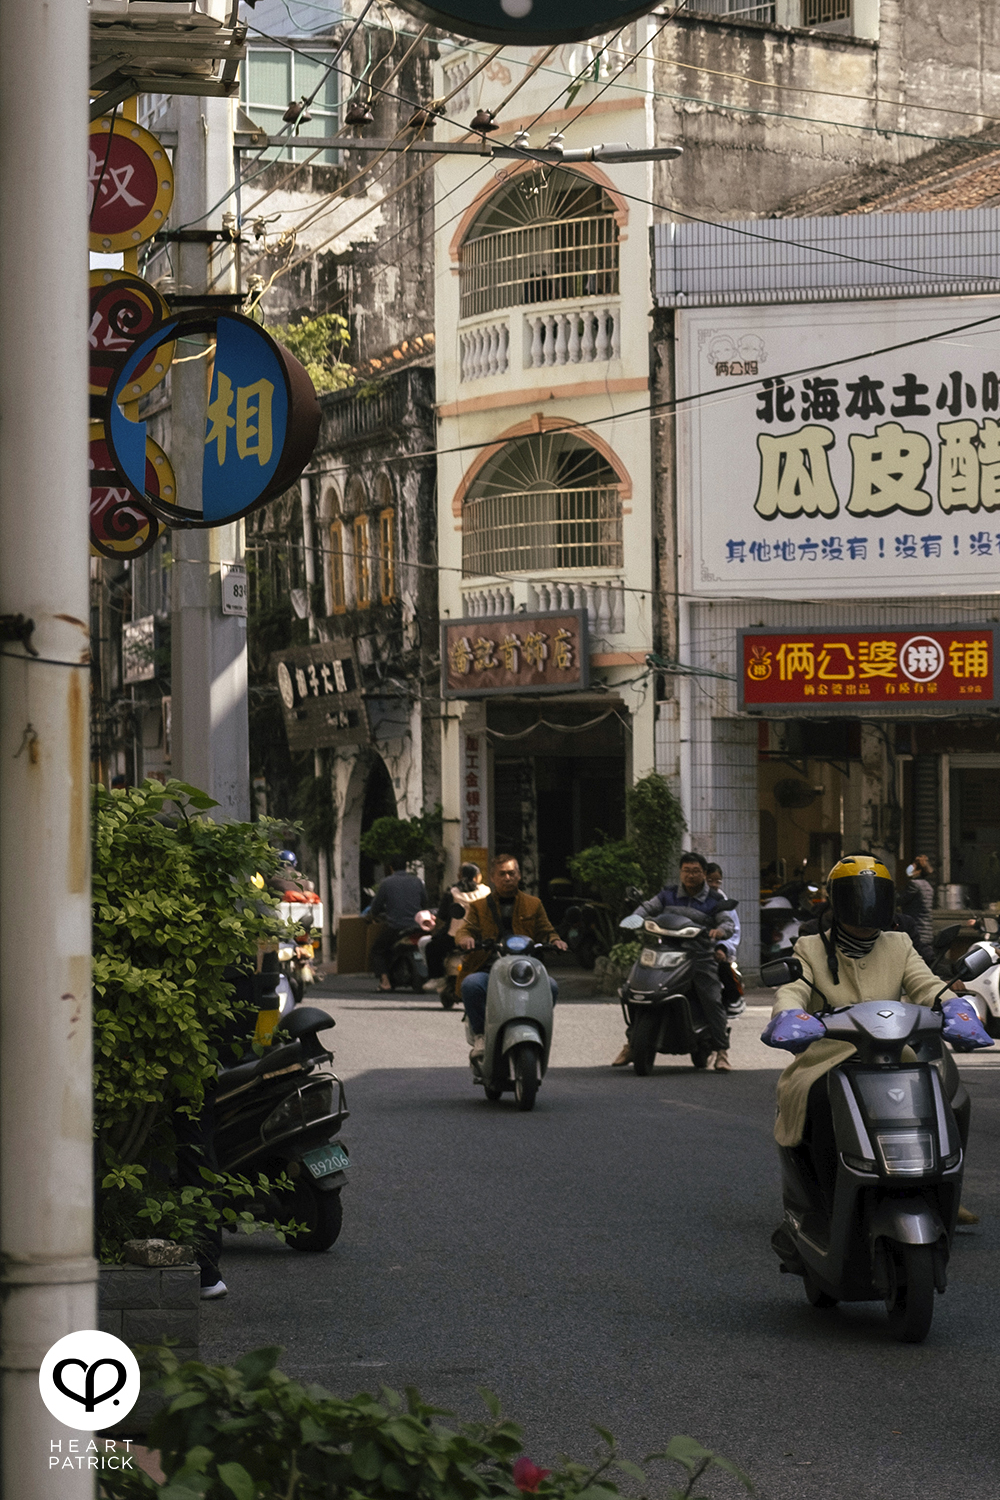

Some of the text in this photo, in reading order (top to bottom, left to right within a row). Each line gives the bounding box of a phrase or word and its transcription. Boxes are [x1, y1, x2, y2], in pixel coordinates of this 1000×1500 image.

[776, 637, 989, 682] 俩公婆粥铺
[310, 1155, 348, 1176] B9206
